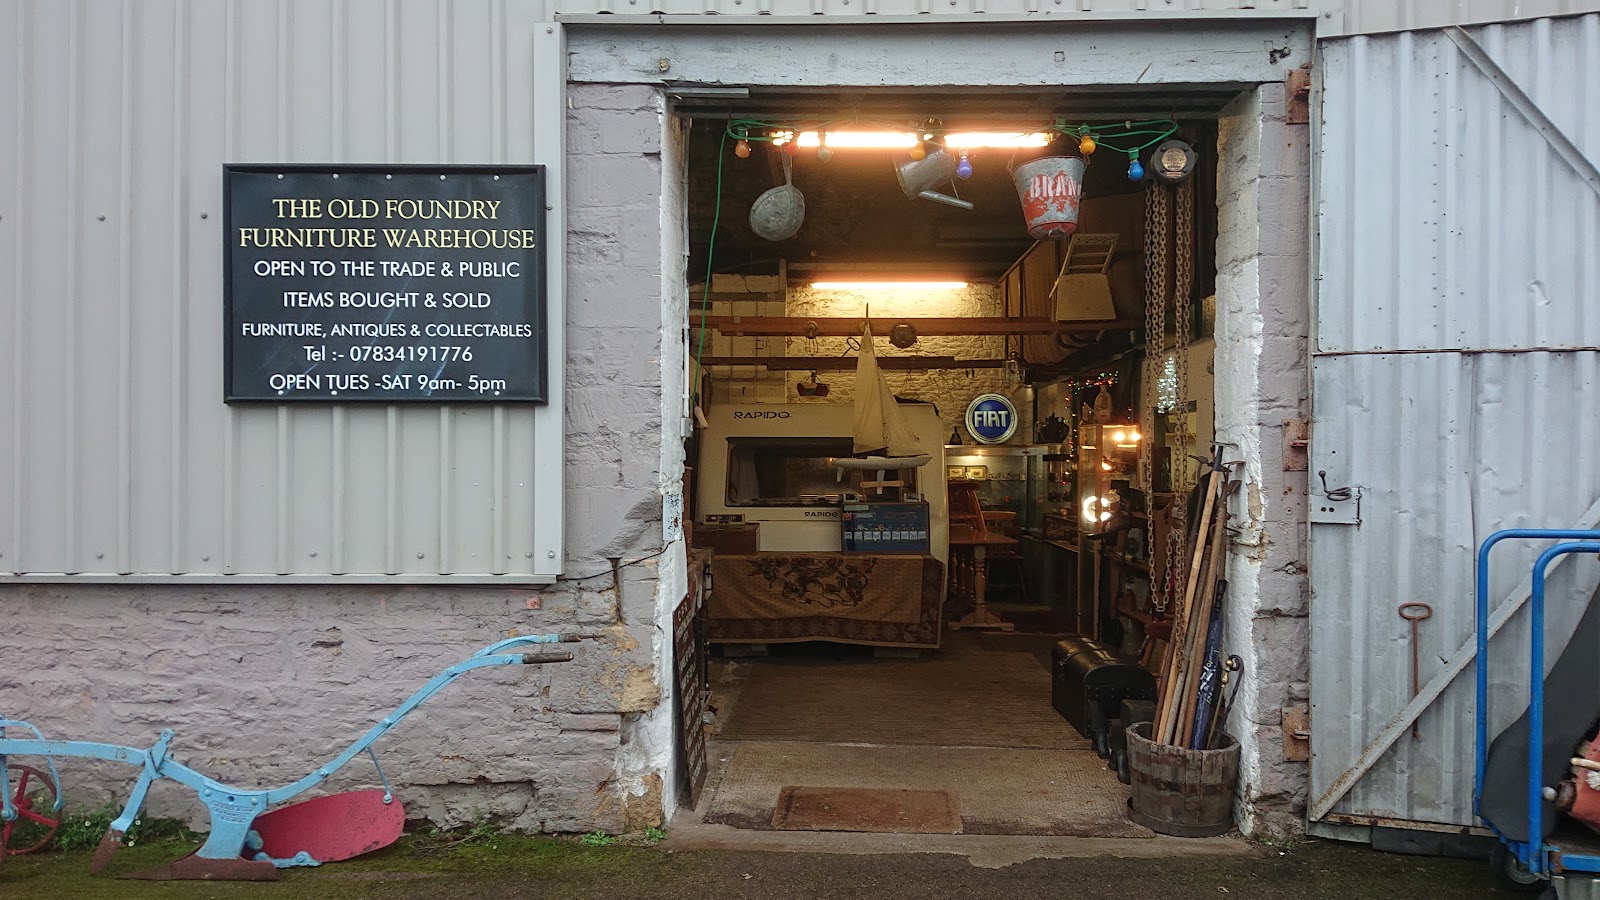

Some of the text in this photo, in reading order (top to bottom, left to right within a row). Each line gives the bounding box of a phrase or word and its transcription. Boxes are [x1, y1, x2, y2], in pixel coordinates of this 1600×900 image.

[272, 199, 501, 219] THE OLD FOUNDRY
[239, 228, 535, 248] FURNITURE WAREHOUSE
[254, 261, 520, 277] OPEN TO THE TRADE & PUBLIC
[284, 292, 491, 308] ITEMS BOUGHT & SOLD
[243, 323, 532, 338] FURNITURE, ANTIQUES & COLLECTABLES
[303, 345, 325, 361] Tel
[350, 346, 472, 363] 07834191776
[269, 374, 506, 393] OPEN TUES -SAT 9am- 5pm
[974, 410, 1008, 427] FIAT
